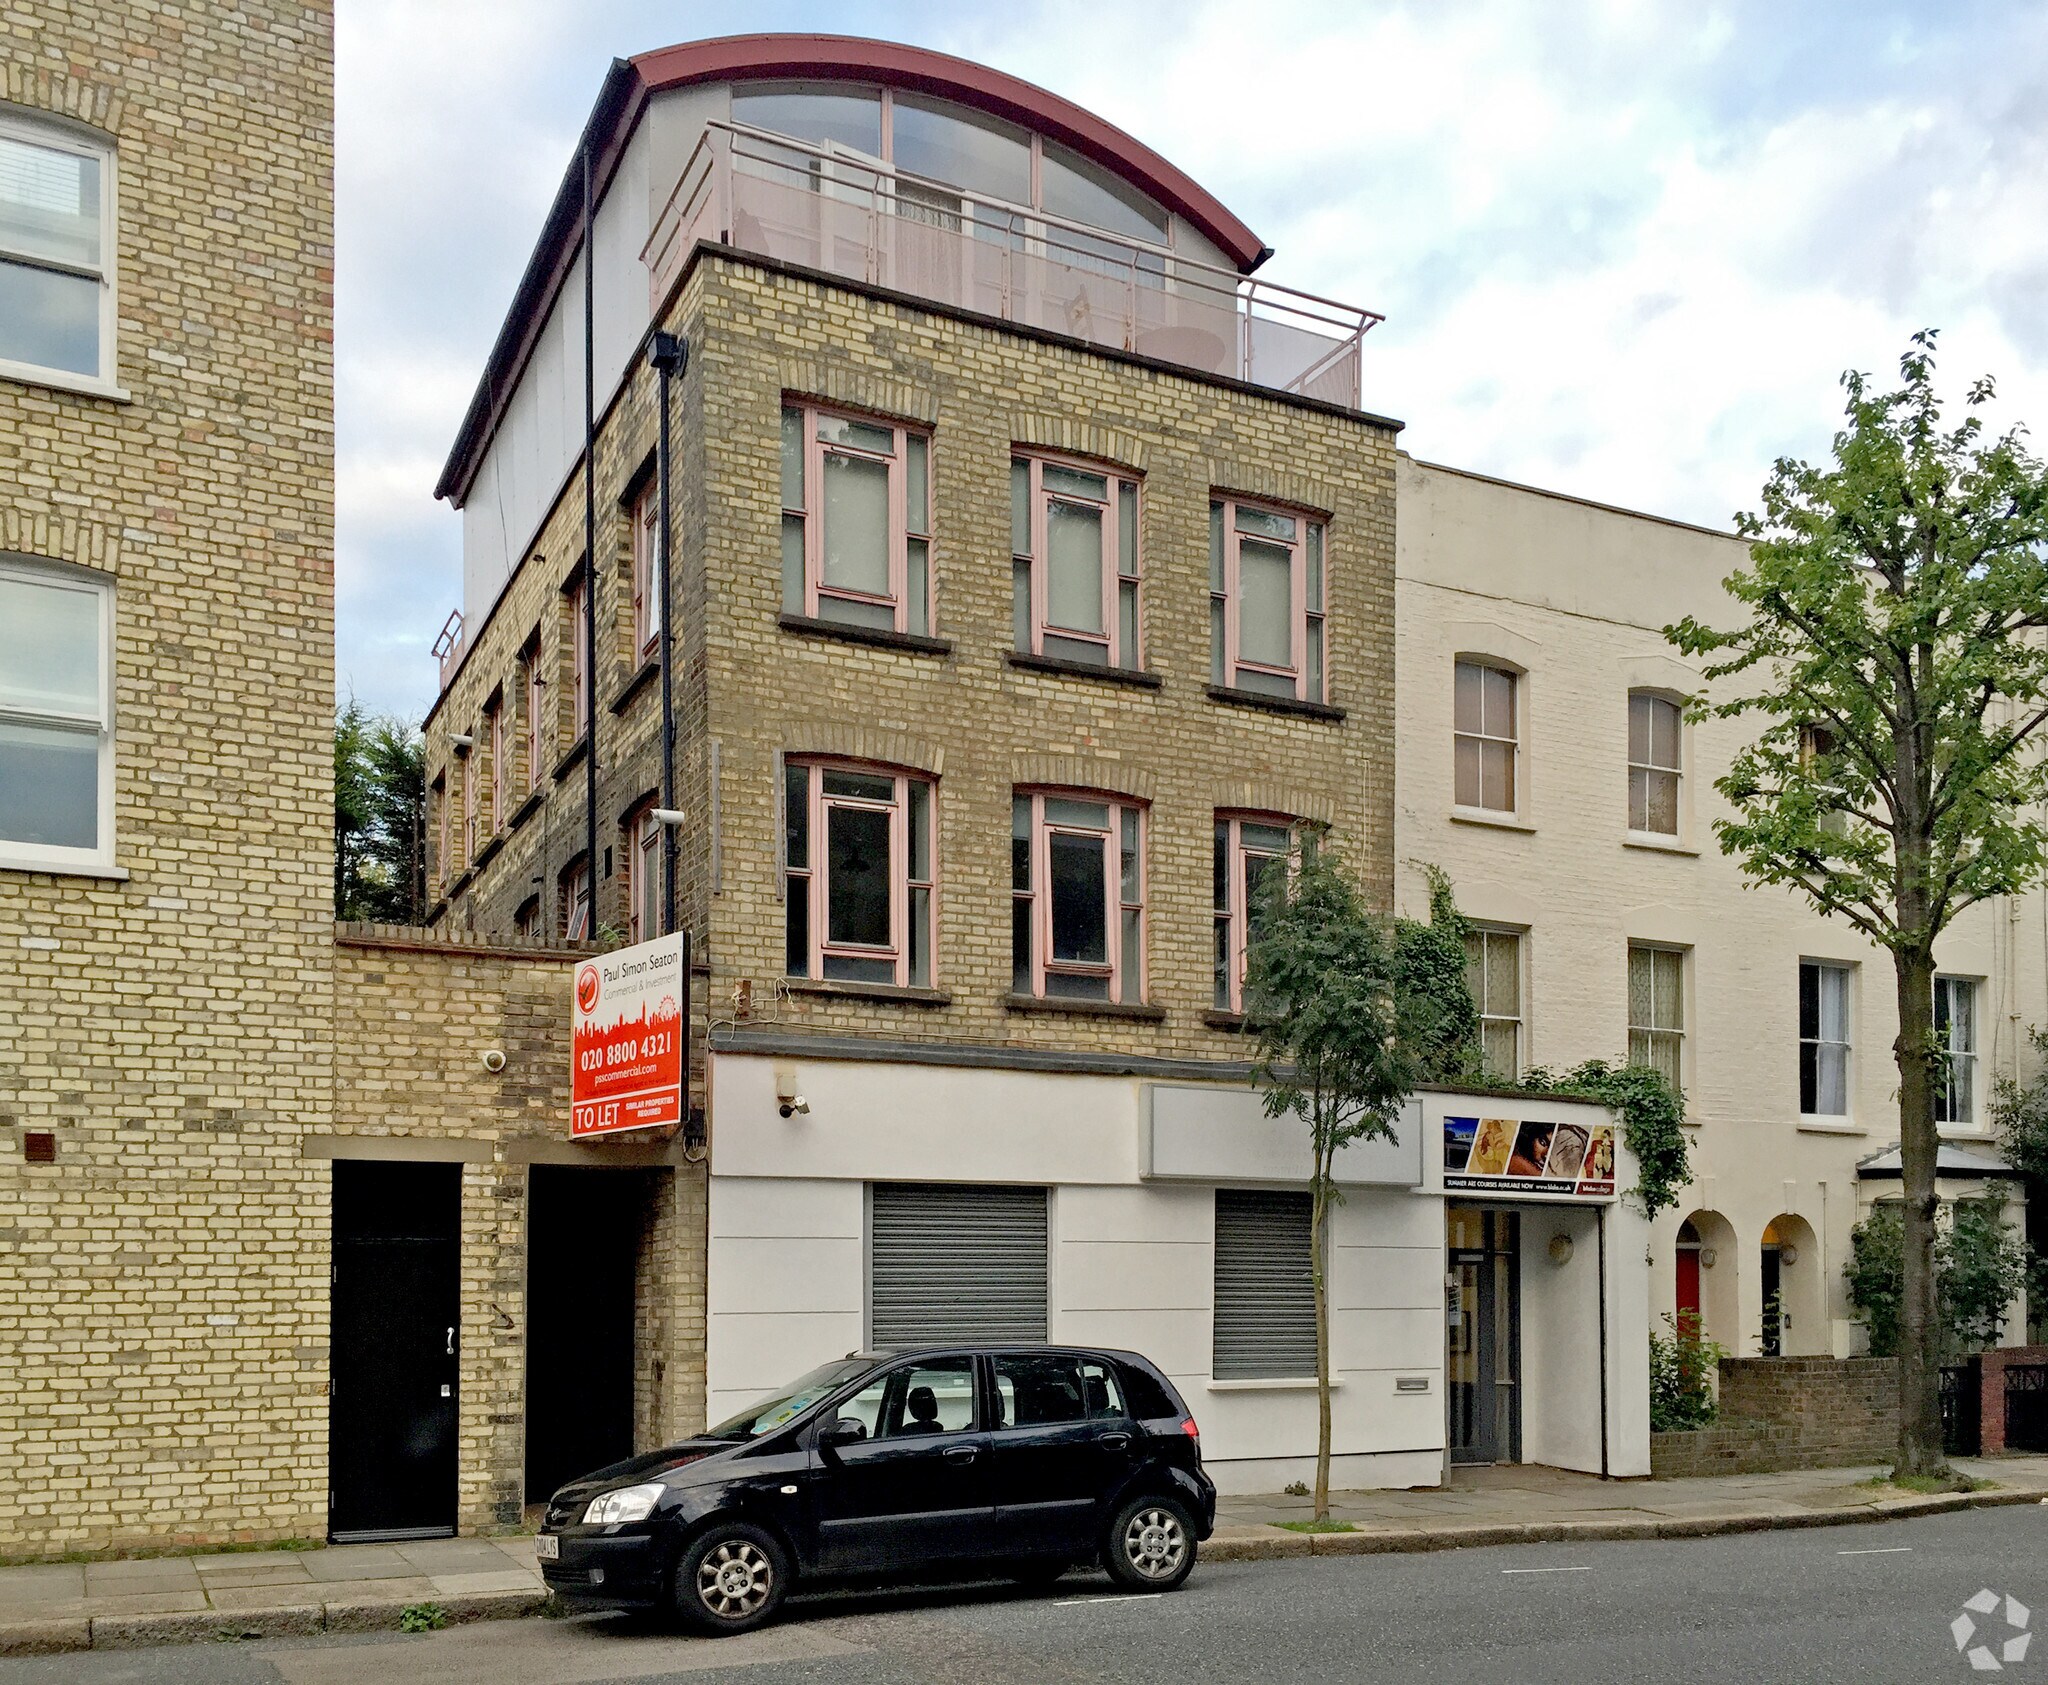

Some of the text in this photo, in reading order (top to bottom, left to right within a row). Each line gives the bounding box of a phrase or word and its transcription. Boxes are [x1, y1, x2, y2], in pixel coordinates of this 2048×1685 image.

[603, 952, 678, 983] Paul Simon Seaton
[603, 972, 677, 1001] Commercial & Investment
[581, 1031, 671, 1072] 020 8800 4321
[575, 1102, 620, 1129] TO LET
[625, 1095, 675, 1111] SIMILAR PROPERTIES
[637, 1107, 662, 1118] REQUIRED
[1447, 1179, 1467, 1187] SUMMER
[1476, 1180, 1498, 1188] COURSES
[1498, 1181, 1521, 1189] AVAILABLE
[1521, 1182, 1534, 1190] NOW
